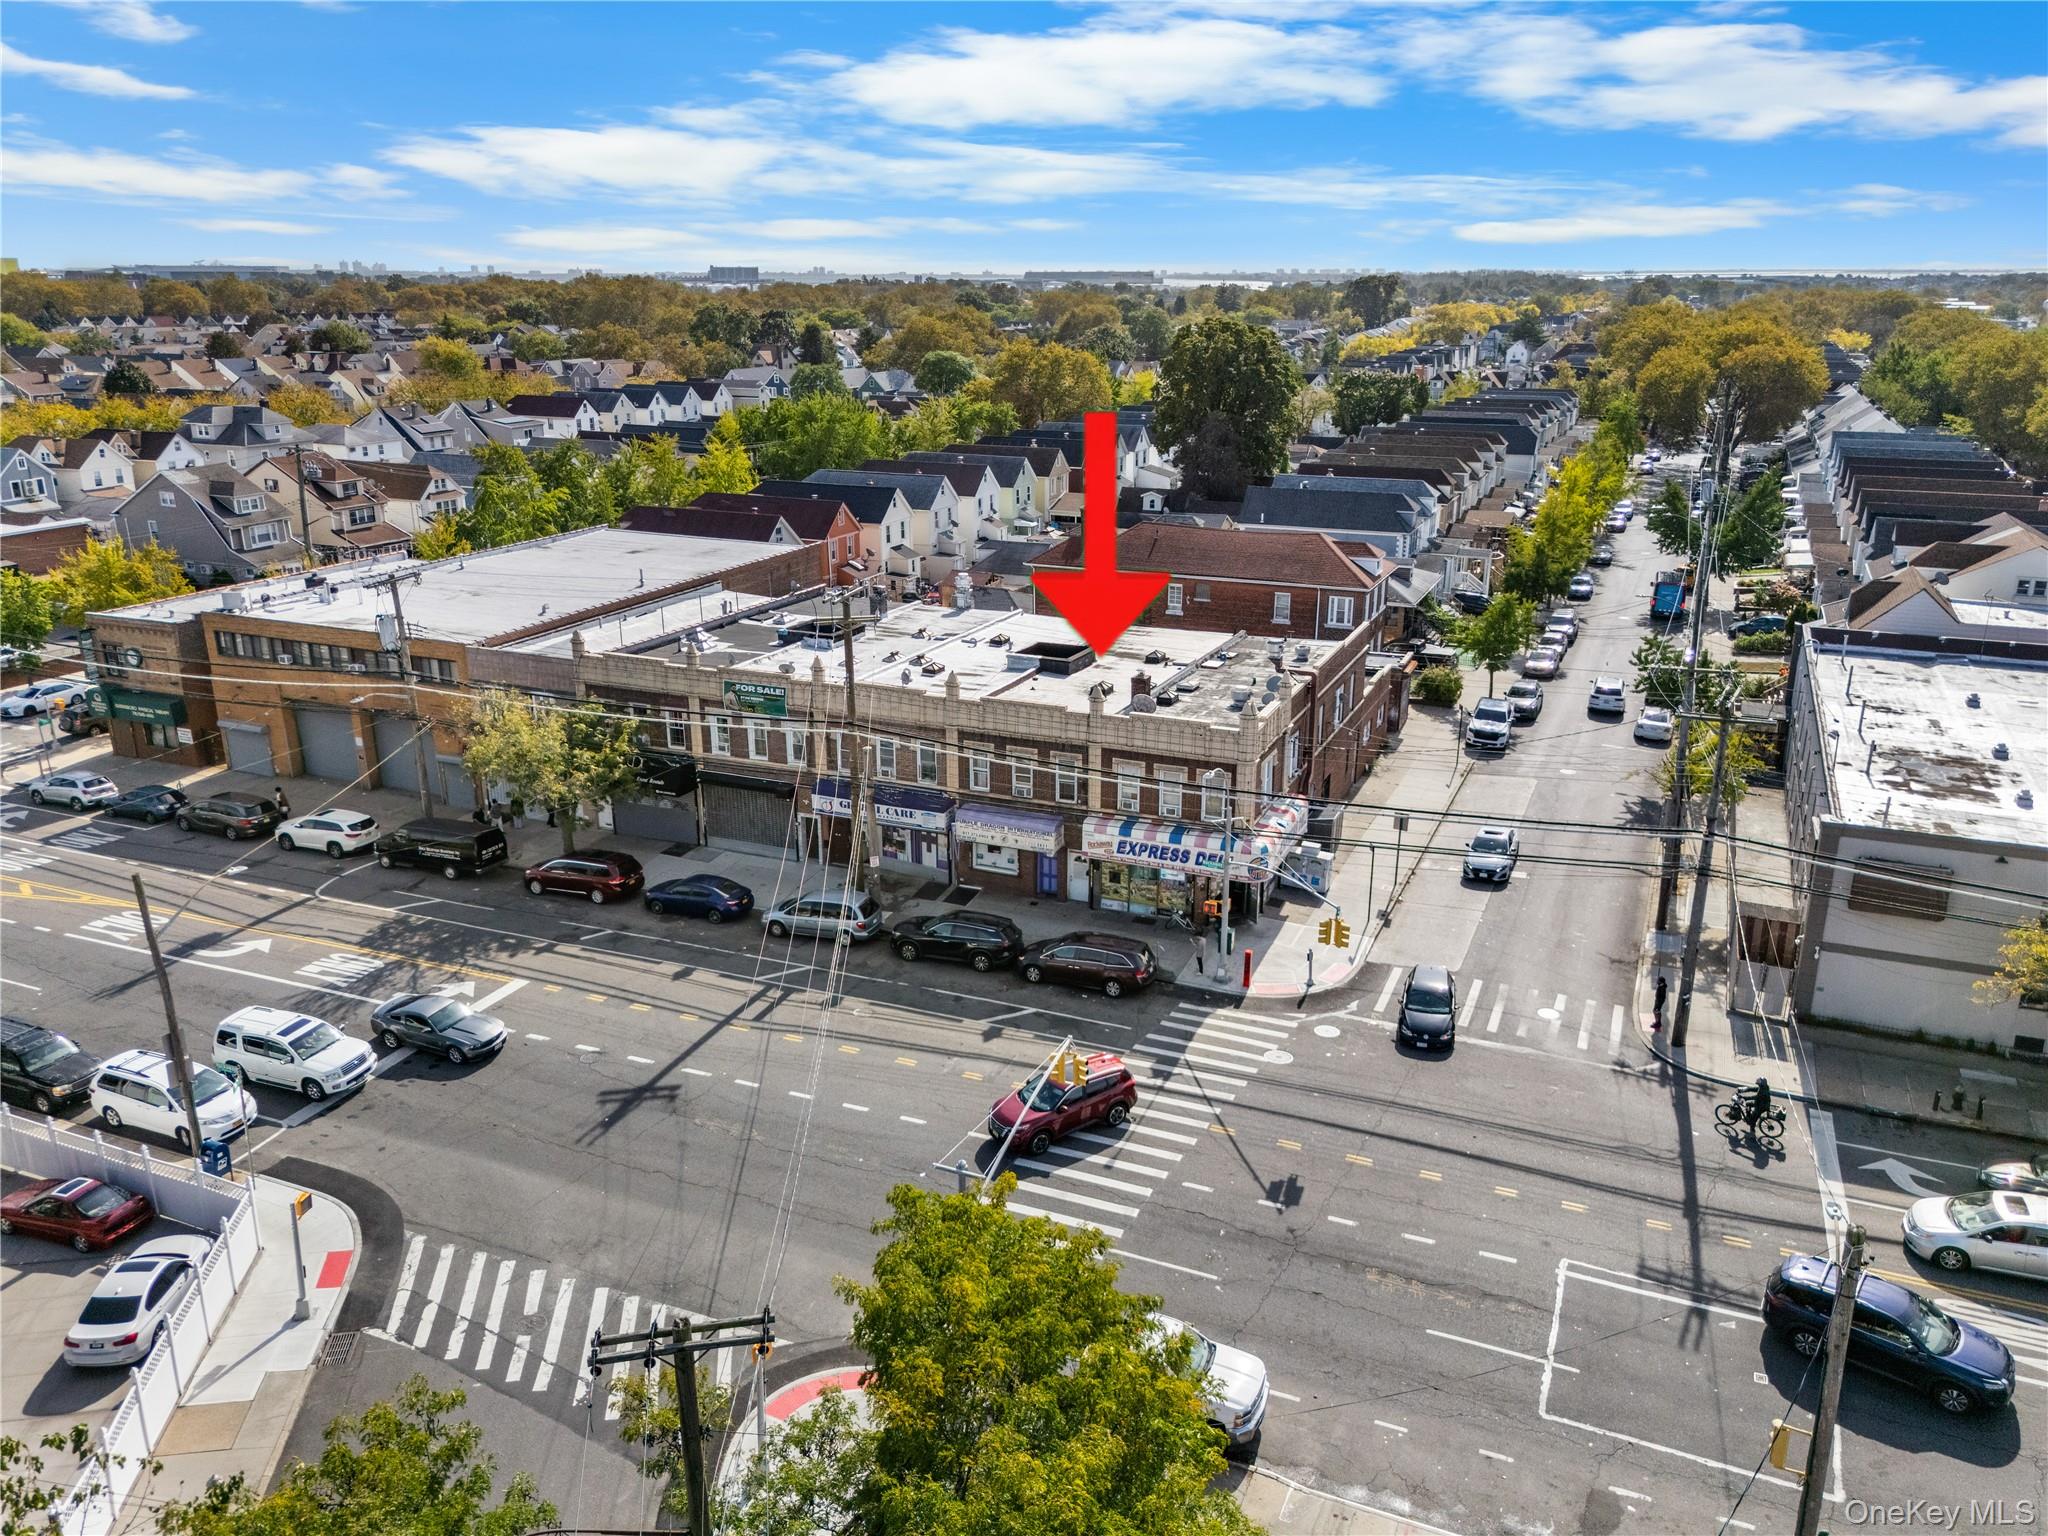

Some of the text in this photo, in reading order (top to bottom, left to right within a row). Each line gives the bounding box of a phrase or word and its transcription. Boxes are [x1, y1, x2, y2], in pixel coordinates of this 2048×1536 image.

[735, 684, 785, 696] FOR SALE!
[885, 807, 917, 819] CARE
[980, 822, 1006, 830] DRAGON
[49, 827, 125, 849] ONLY
[1116, 839, 1191, 864] EXPRESS
[1194, 851, 1234, 866] DEL
[80, 910, 171, 943] ONLY
[294, 953, 386, 988] ONLY
